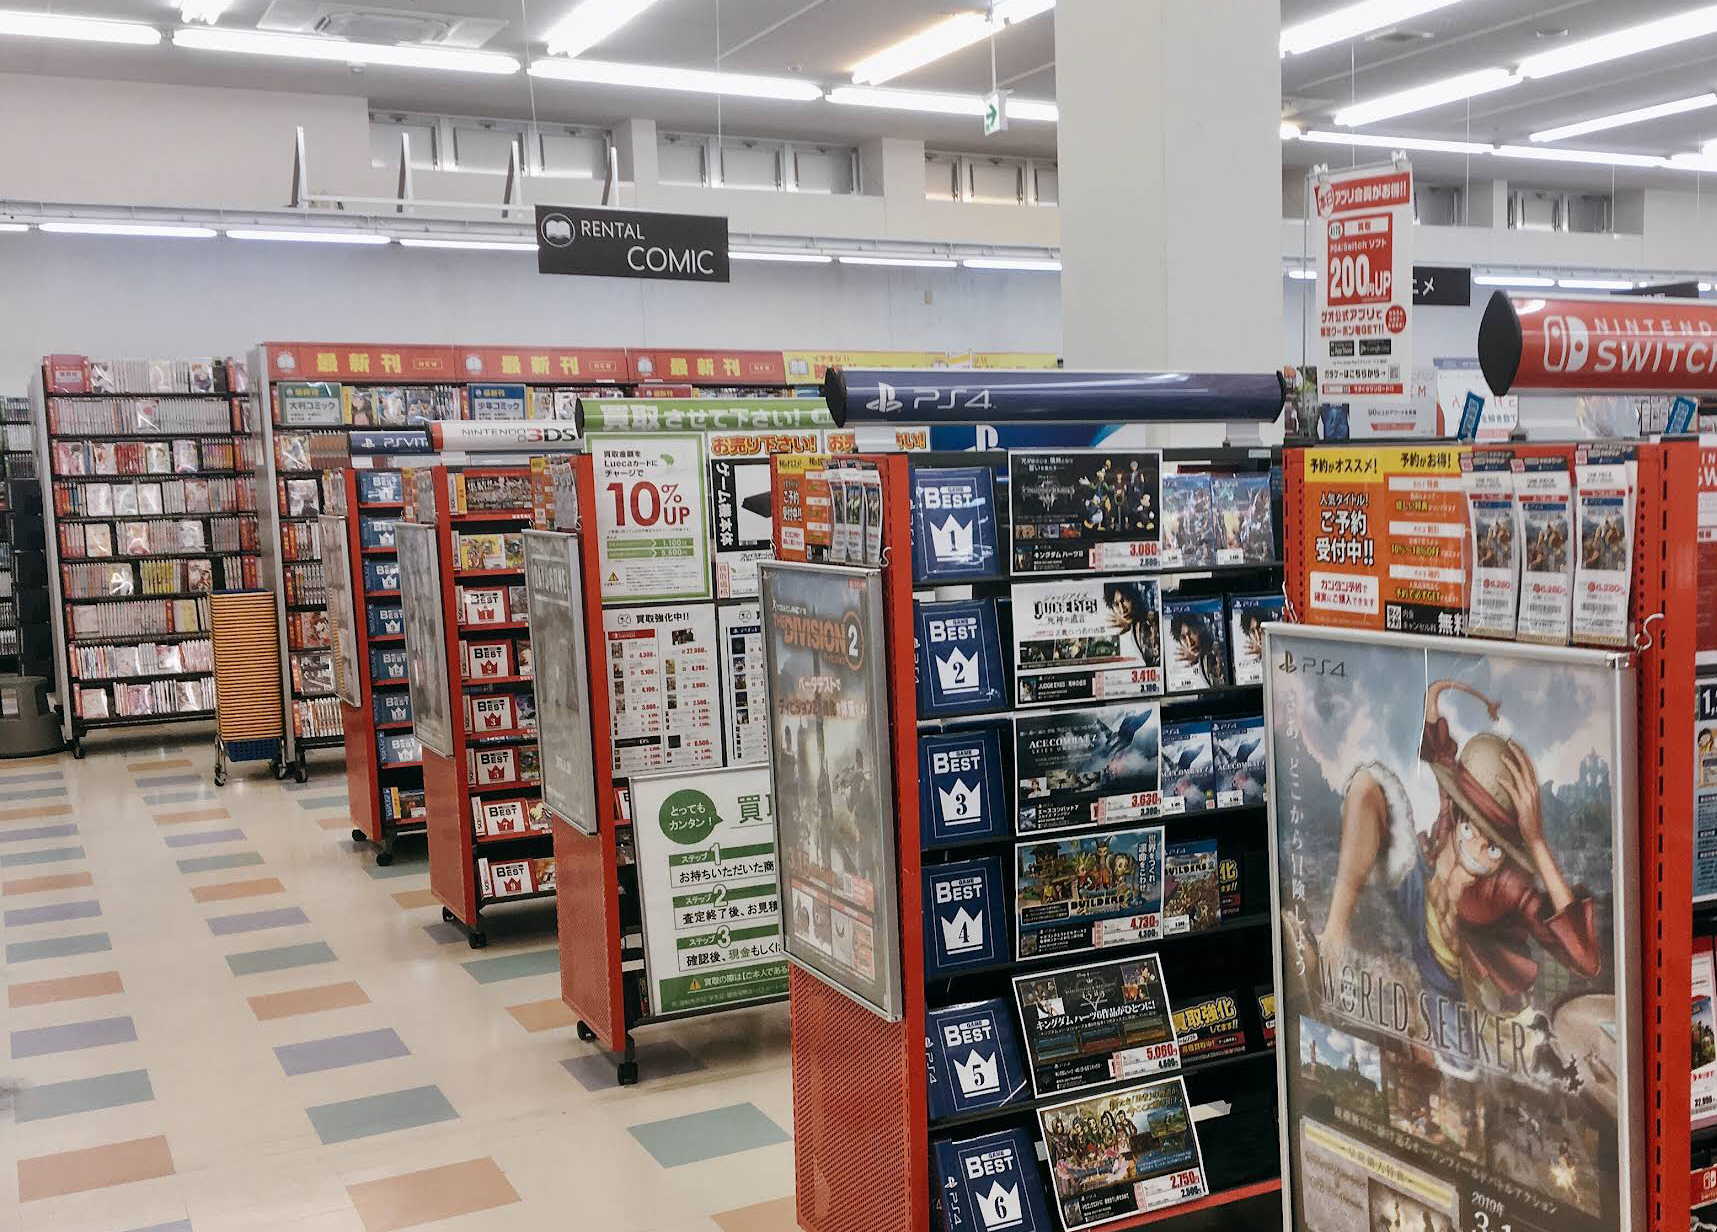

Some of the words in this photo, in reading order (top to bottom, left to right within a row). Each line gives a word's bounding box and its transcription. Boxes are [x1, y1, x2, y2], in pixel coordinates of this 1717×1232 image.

[581, 219, 645, 240] RENTAL
[627, 246, 714, 274] COMIC
[912, 387, 995, 410] PS4
[1310, 458, 1377, 474] 予約がオススメ!
[1400, 452, 1451, 469] 予約がお得!
[923, 486, 974, 509] BEST
[1319, 493, 1369, 506] 人気タイトル!
[663, 506, 690, 526] UP
[1320, 510, 1367, 536] ご予約
[949, 530, 956, 551] 1
[1315, 537, 1374, 566] 受付中!!
[848, 624, 858, 657] 2
[929, 620, 977, 643] BEST
[474, 645, 502, 658] BEST
[953, 662, 965, 684] 2
[1303, 657, 1348, 678] PS4
[477, 699, 505, 712] BEST
[481, 752, 509, 765] BEST
[932, 752, 981, 775] BEST
[489, 805, 517, 817] BEST
[670, 803, 706, 817] とっても
[737, 794, 772, 824] 買
[955, 793, 968, 815] 3
[681, 853, 708, 864] ステップ
[710, 842, 721, 866] 1
[496, 865, 524, 877] BEST
[712, 884, 729, 907] 2
[936, 881, 982, 903] BEST
[716, 925, 732, 949] 3
[958, 921, 970, 944] 4
[1319, 955, 1408, 1033] WORLD
[1419, 990, 1530, 1078] SEEKER
[943, 1026, 992, 1047] BEST
[972, 1063, 986, 1086] 5
[965, 1155, 1014, 1179] BEST
[994, 1195, 1008, 1219] 6
